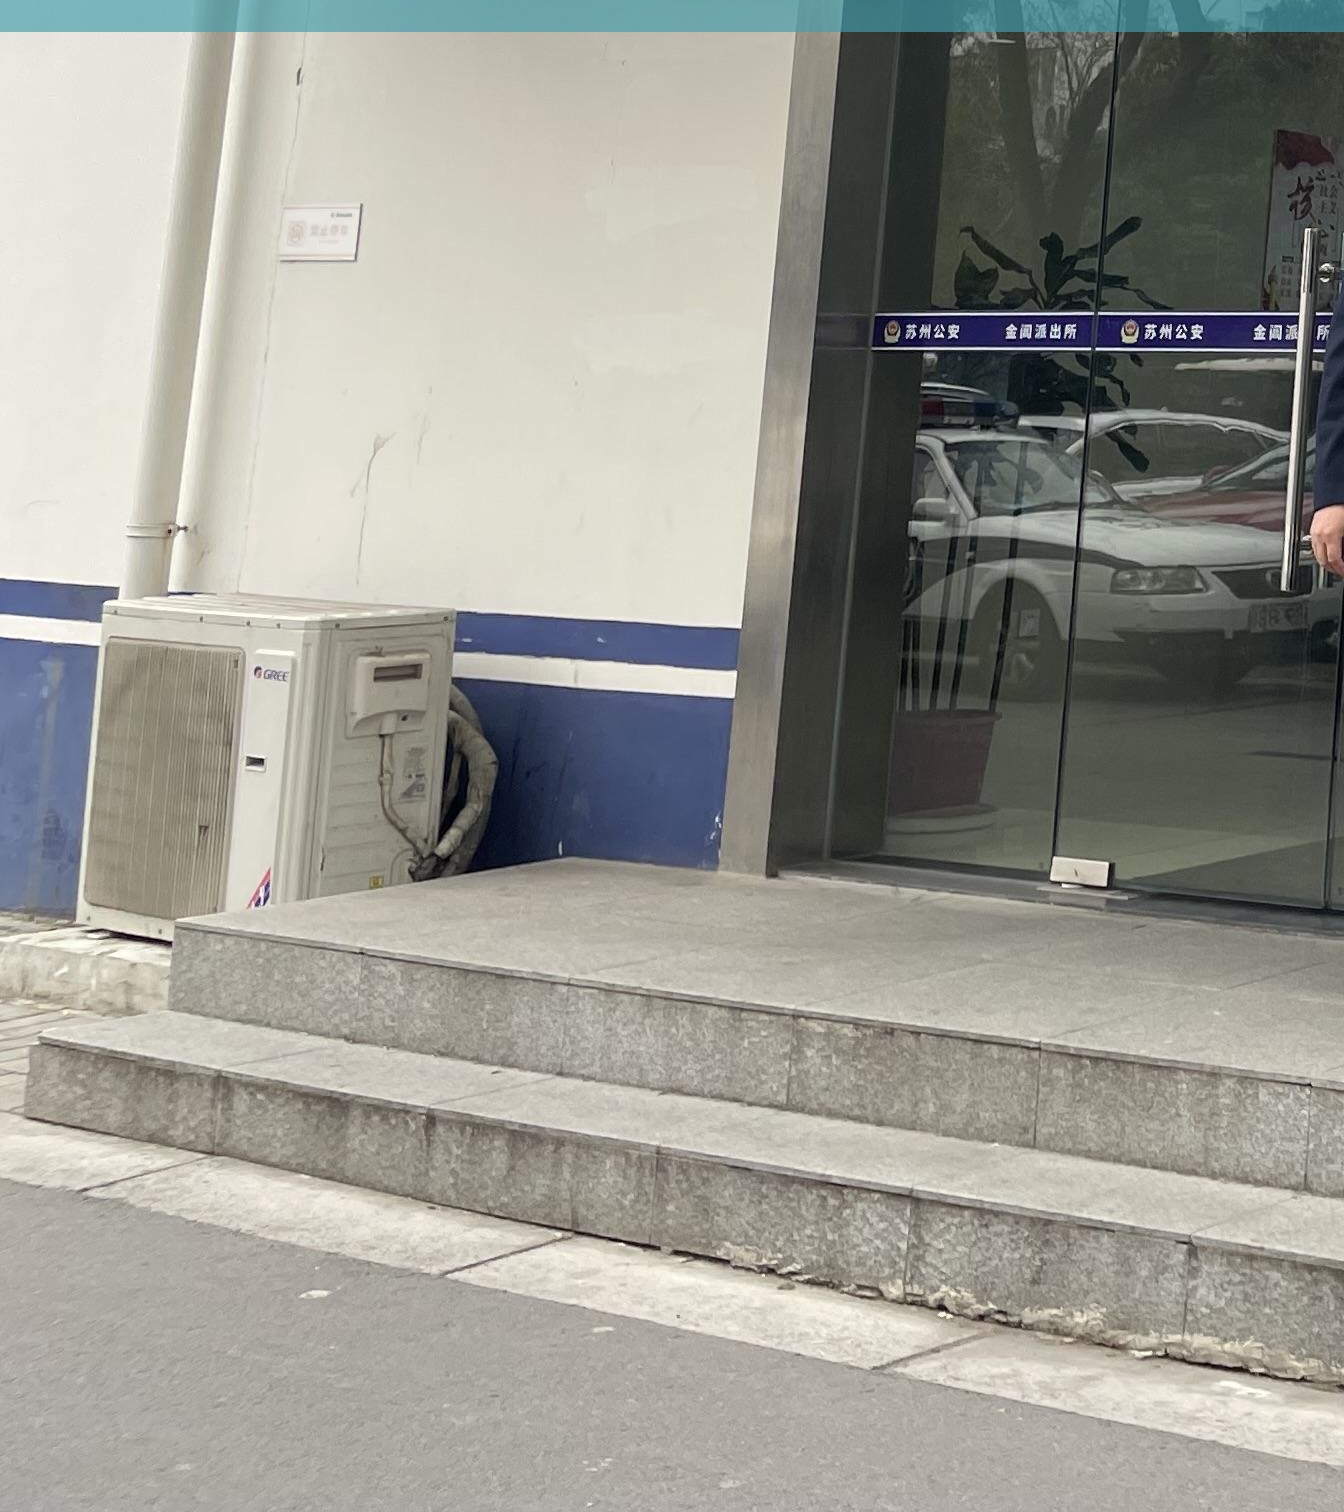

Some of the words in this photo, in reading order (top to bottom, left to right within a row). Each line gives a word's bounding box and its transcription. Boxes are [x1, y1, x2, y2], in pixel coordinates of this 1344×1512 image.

[905, 323, 961, 340] 苏州公安
[1143, 323, 1205, 341] 苏州公安
[1252, 323, 1332, 341] 金阊派所
[263, 668, 290, 682] GREE
